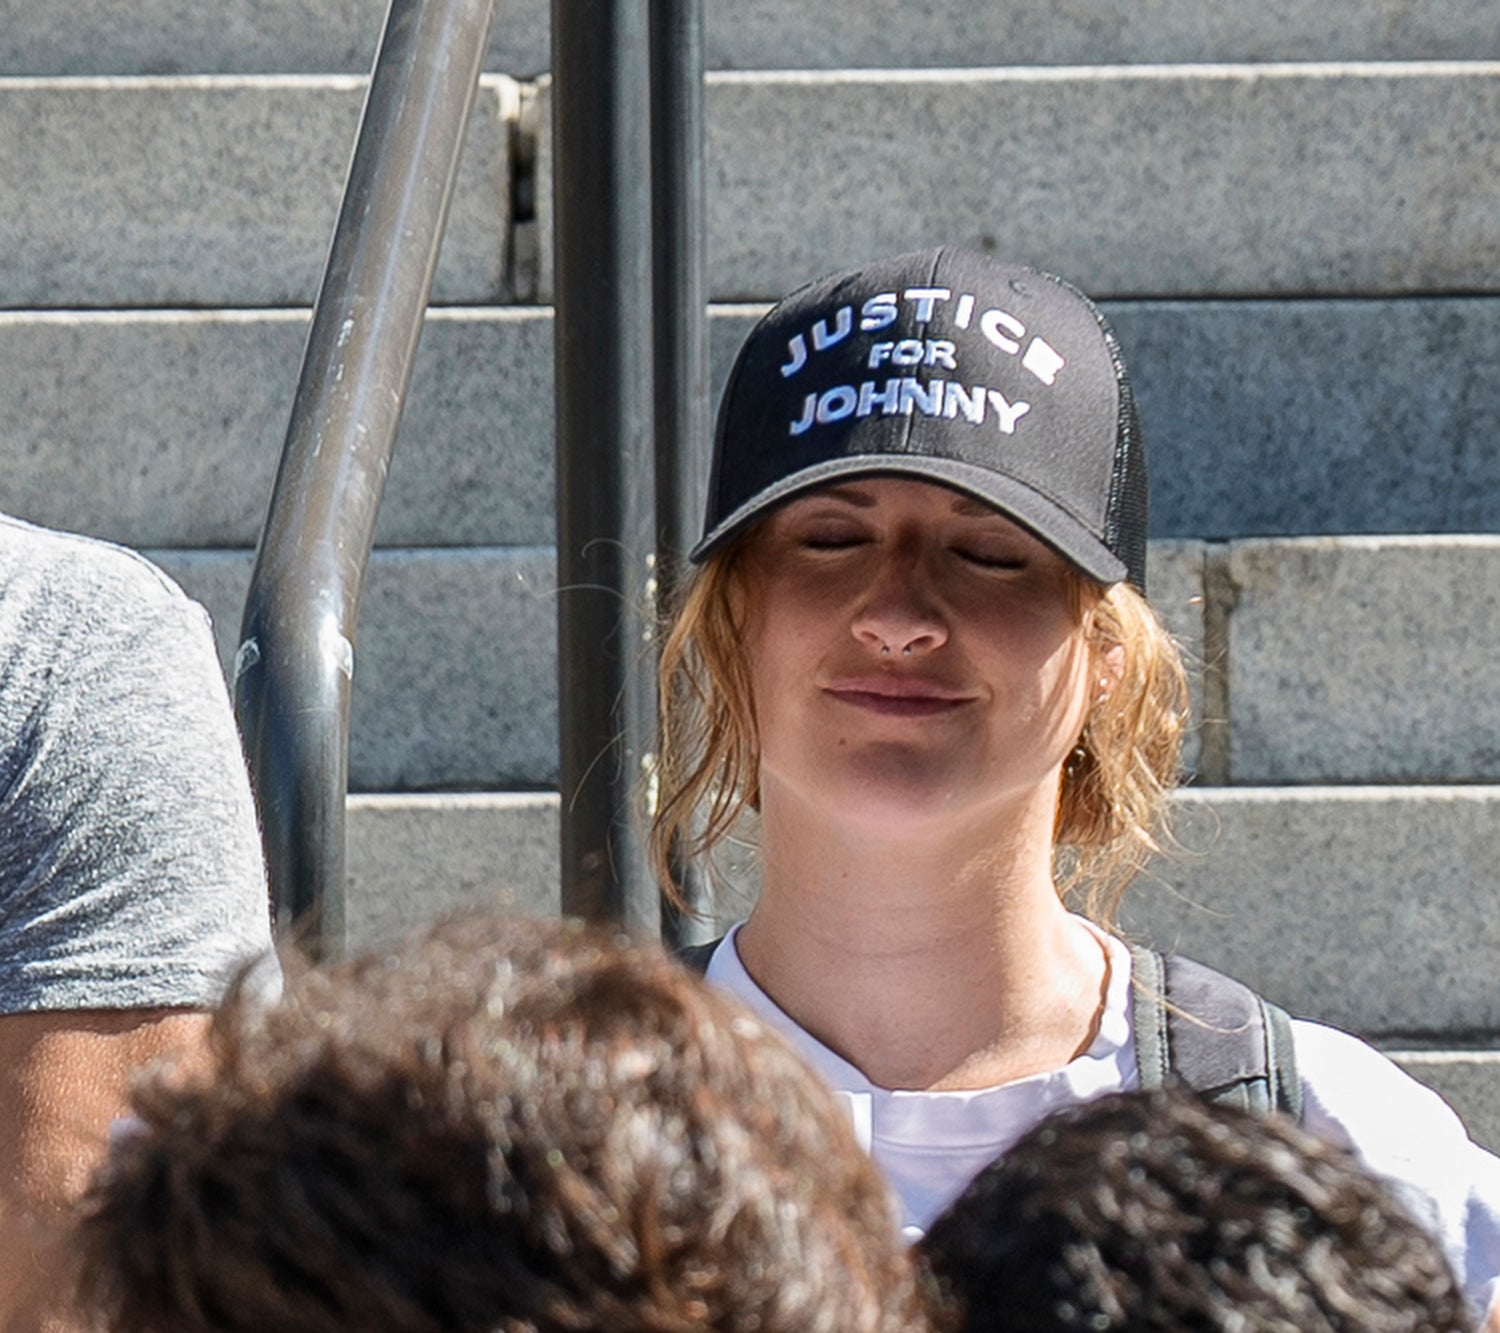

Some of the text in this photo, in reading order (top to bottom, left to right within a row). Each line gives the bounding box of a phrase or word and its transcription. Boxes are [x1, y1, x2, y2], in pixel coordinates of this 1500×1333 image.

[781, 288, 1066, 386] JUSTICE
[868, 339, 957, 369] FOR
[790, 378, 1030, 435] JOHNNY
